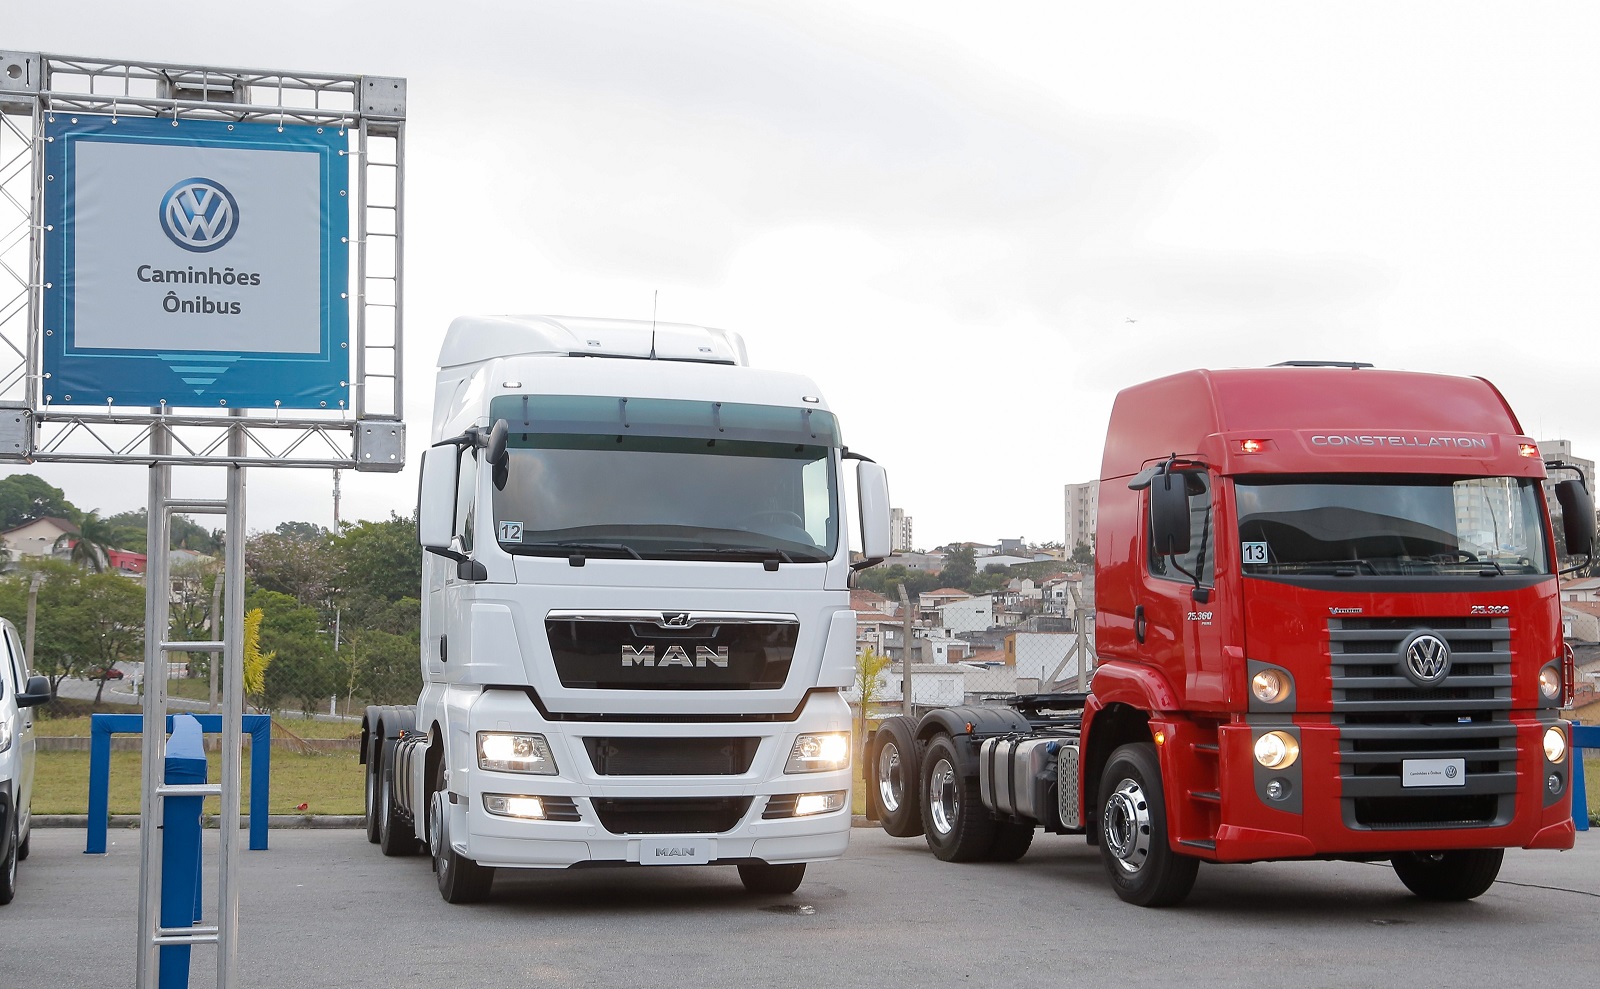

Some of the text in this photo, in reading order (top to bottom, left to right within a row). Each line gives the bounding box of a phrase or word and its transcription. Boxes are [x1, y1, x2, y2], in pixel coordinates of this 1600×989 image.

[136, 264, 261, 286] Caminhões
[162, 290, 242, 315] Ônibus
[1311, 435, 1487, 449] CONSTELLATION
[501, 524, 521, 540] 12
[1245, 544, 1265, 560] 13
[1187, 611, 1213, 621] 25.360
[1470, 605, 1510, 615] 25.360
[621, 644, 729, 668] MAN
[655, 847, 696, 857] MAN
